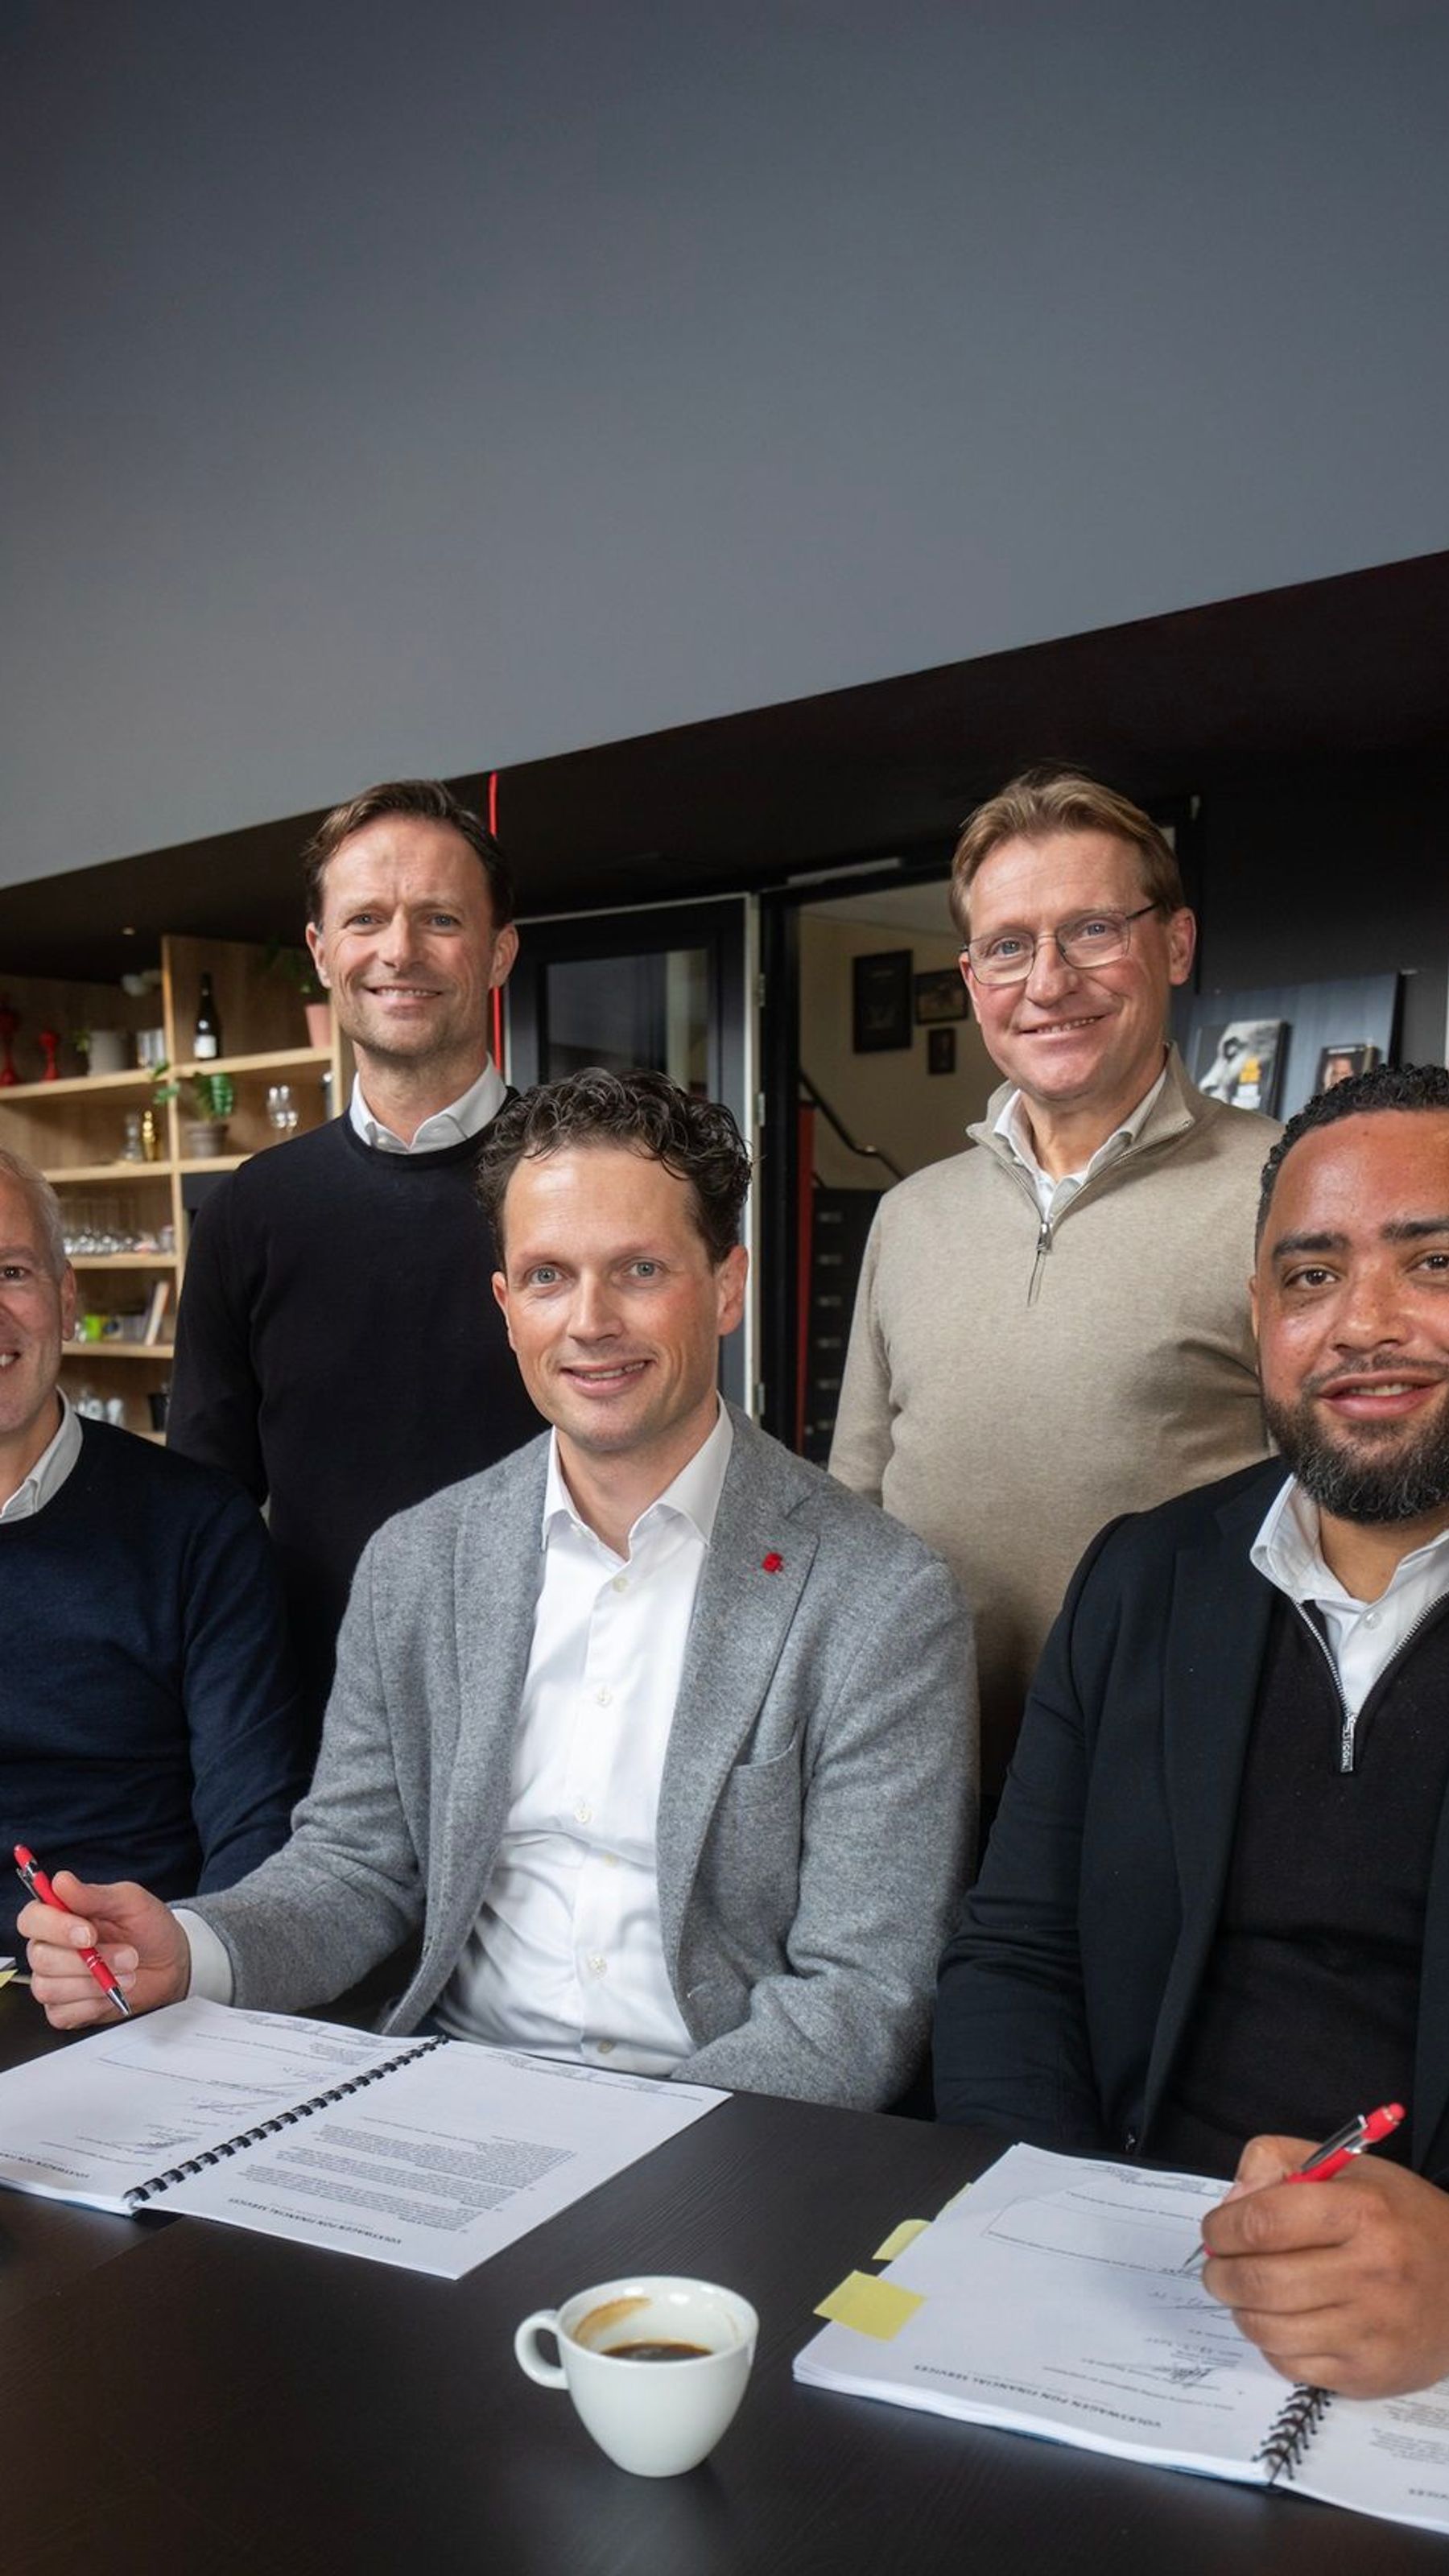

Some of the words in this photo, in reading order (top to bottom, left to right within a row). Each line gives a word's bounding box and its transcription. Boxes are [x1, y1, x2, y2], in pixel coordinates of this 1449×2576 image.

[913, 2364, 970, 2382] SERVICES
[972, 2377, 1038, 2398] FINANCIAL
[1071, 2399, 1162, 2429] VOLKSWAGEN
